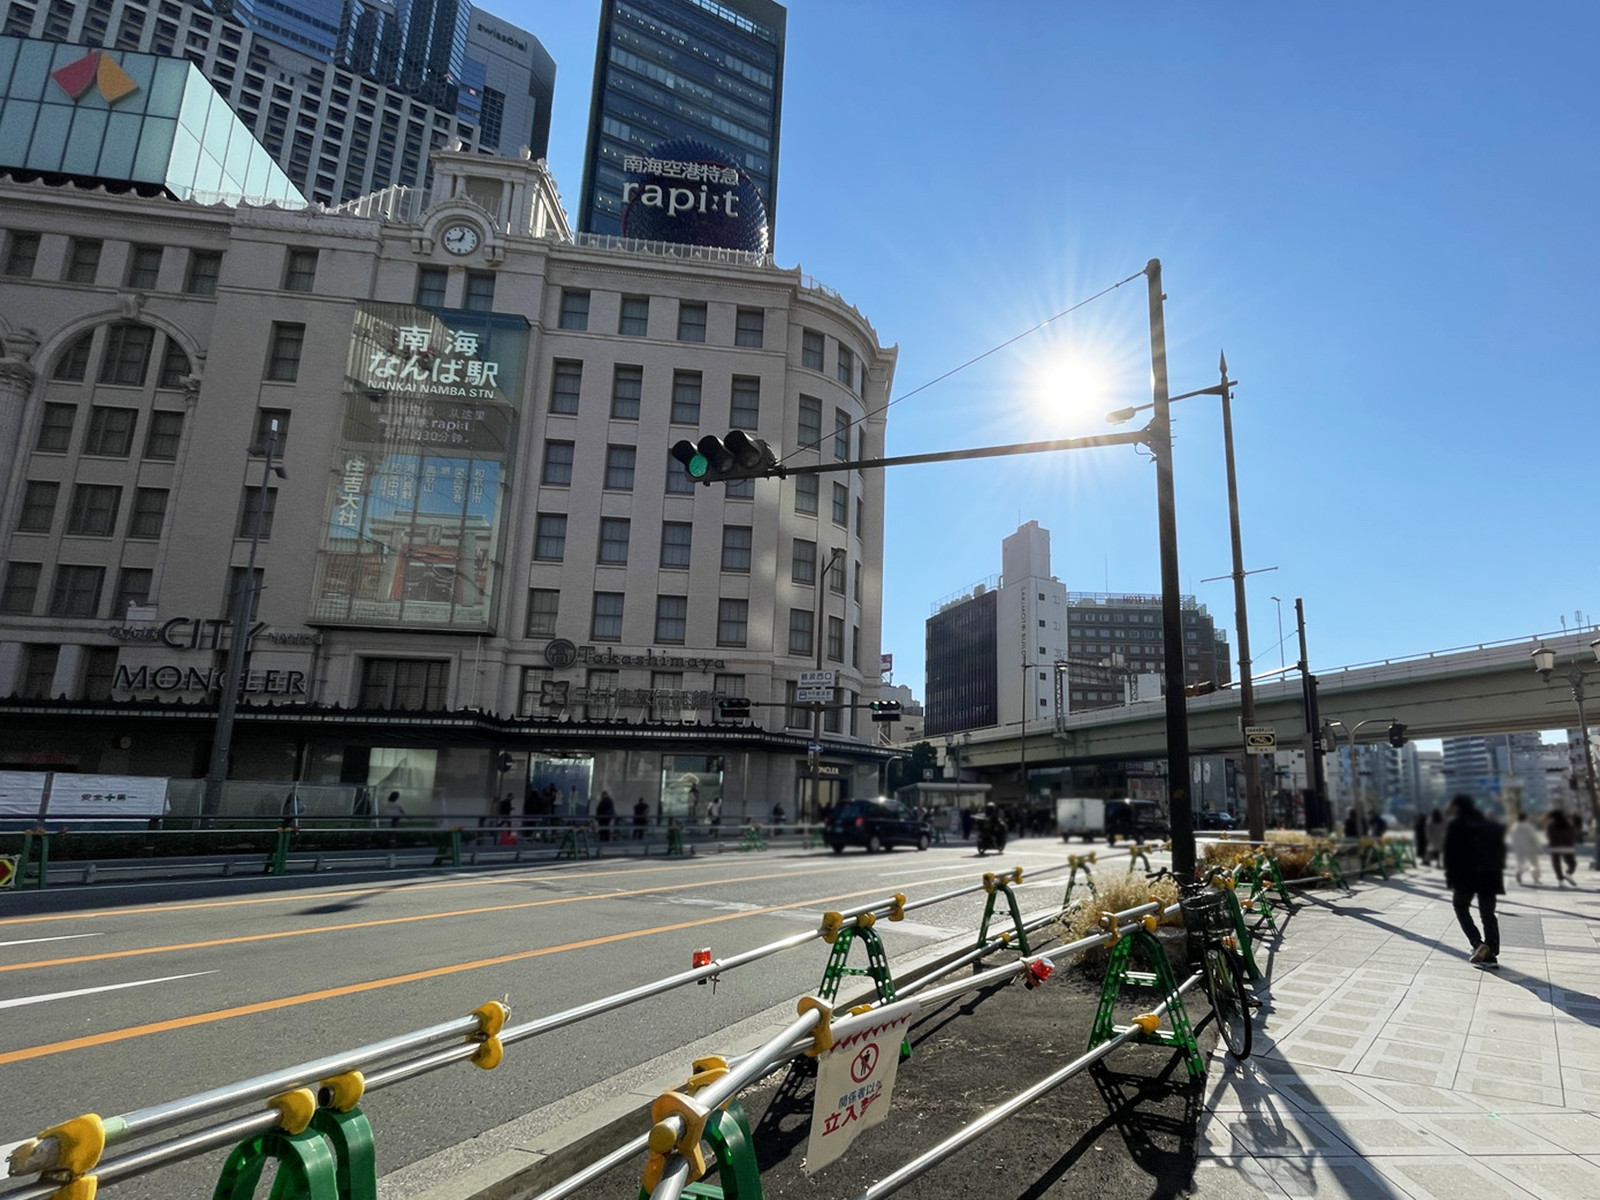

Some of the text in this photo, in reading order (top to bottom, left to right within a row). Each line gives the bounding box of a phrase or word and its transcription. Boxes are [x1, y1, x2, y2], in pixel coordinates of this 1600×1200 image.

[623, 155, 739, 186] 南海空港特急
[398, 325, 480, 357] 南海
[368, 351, 499, 388] なんば駅
[367, 380, 497, 399] NANKAI NAMBA STN.
[338, 458, 365, 526] 住吉大社
[161, 616, 268, 651] CITY
[578, 645, 726, 673] Takashimaya
